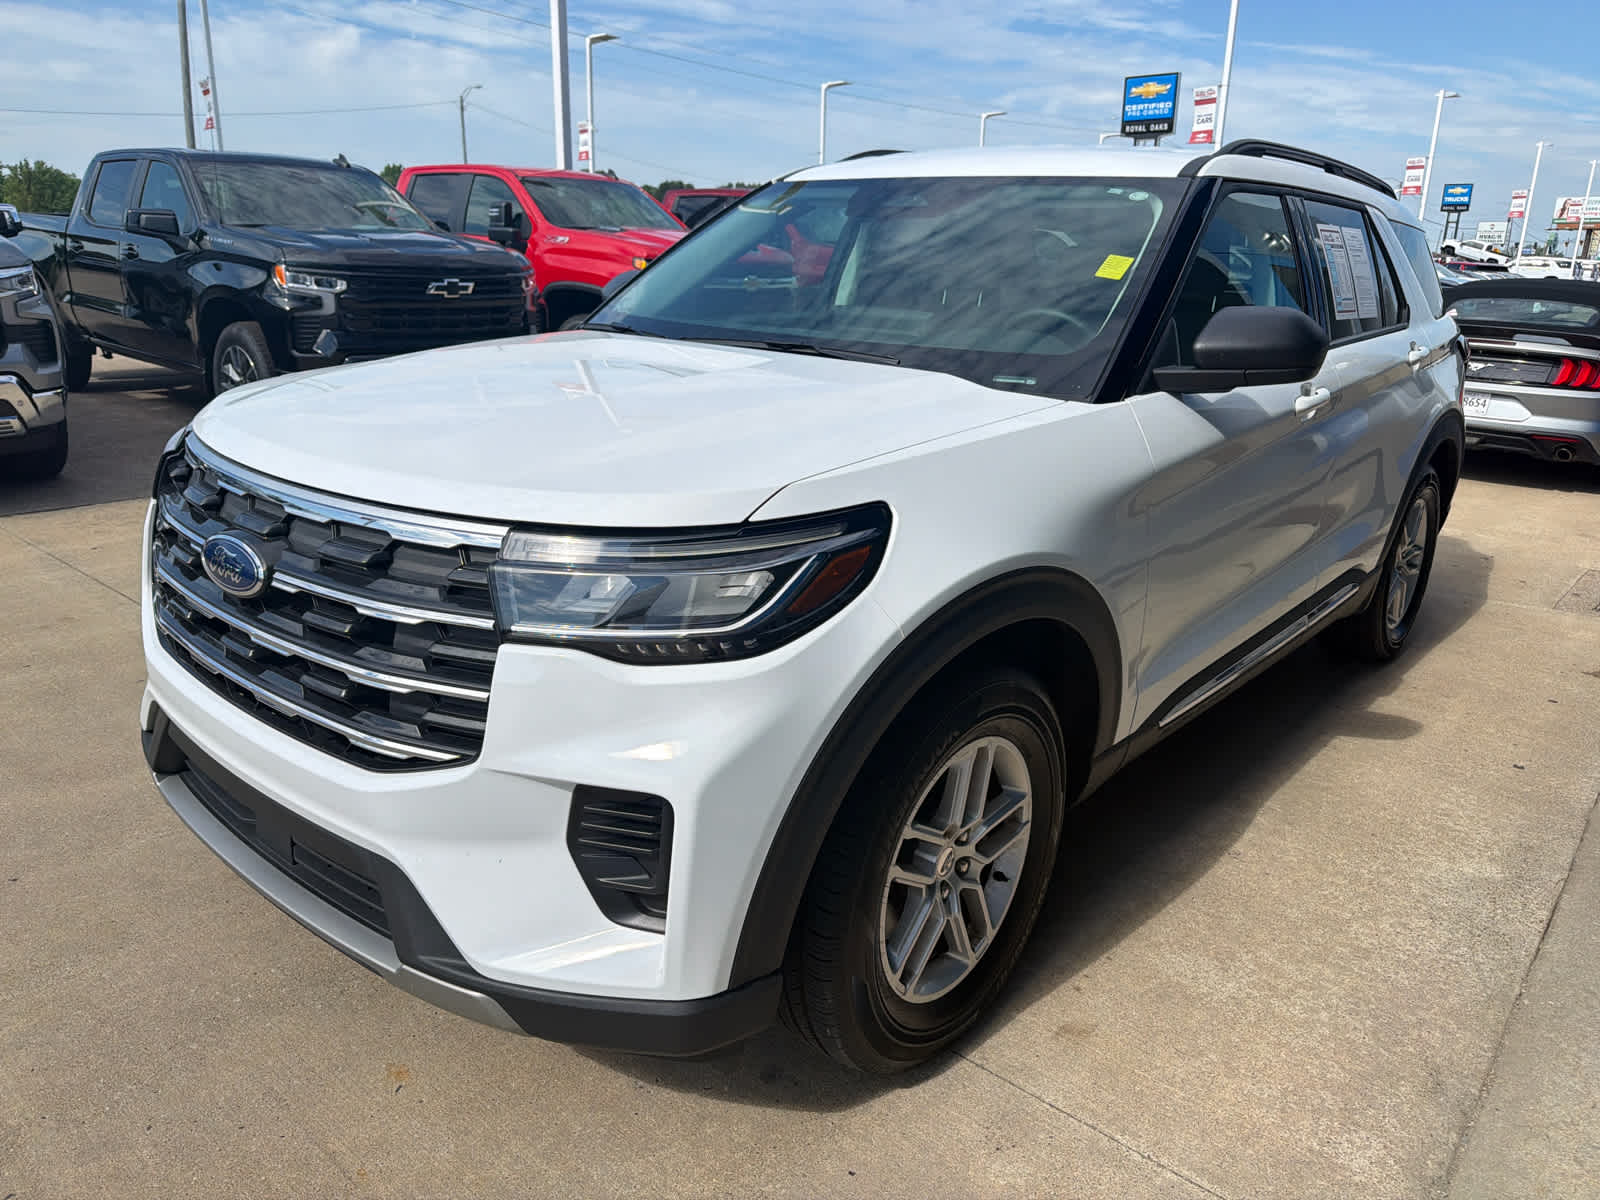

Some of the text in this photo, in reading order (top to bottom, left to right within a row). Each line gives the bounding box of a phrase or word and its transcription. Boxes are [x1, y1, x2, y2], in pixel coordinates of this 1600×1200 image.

[1125, 102, 1172, 111] CERTIFIED
[1125, 123, 1168, 133] ROYAL OAKS
